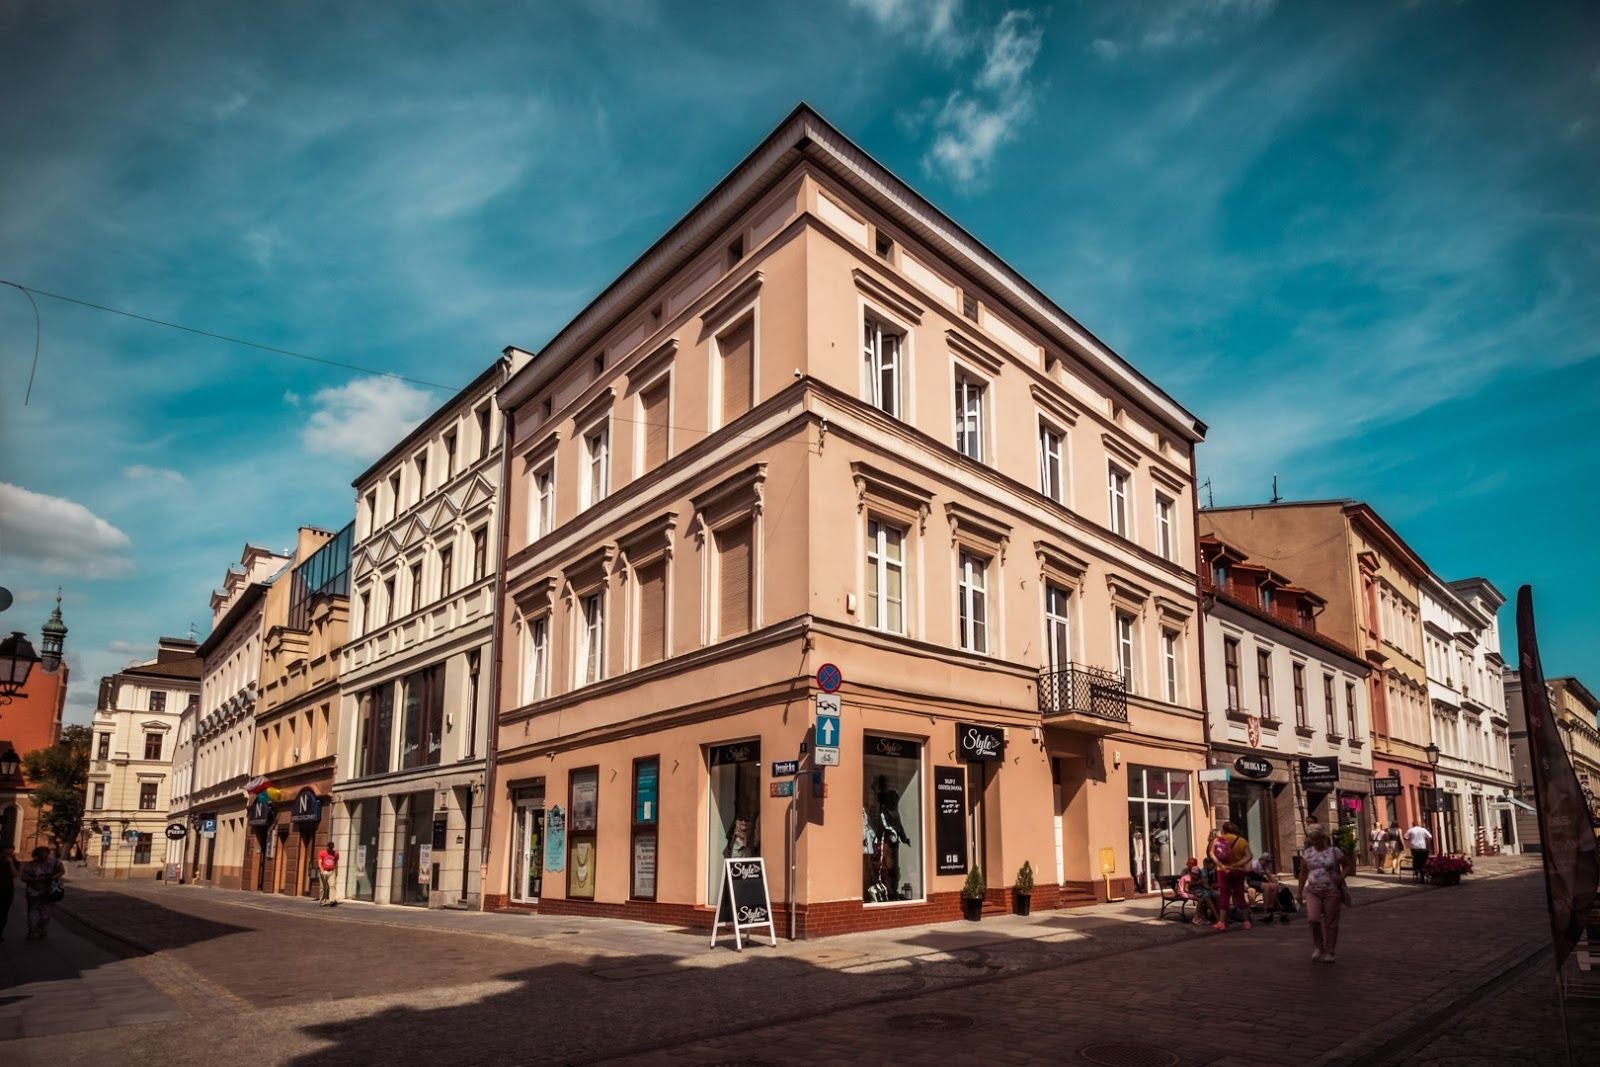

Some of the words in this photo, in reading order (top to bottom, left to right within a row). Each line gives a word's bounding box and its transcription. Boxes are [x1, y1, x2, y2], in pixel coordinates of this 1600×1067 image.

[963, 728, 992, 755] Style
[255, 803, 262, 818] N
[299, 794, 307, 814] N
[731, 862, 754, 879] Style
[738, 906, 761, 923] Style
